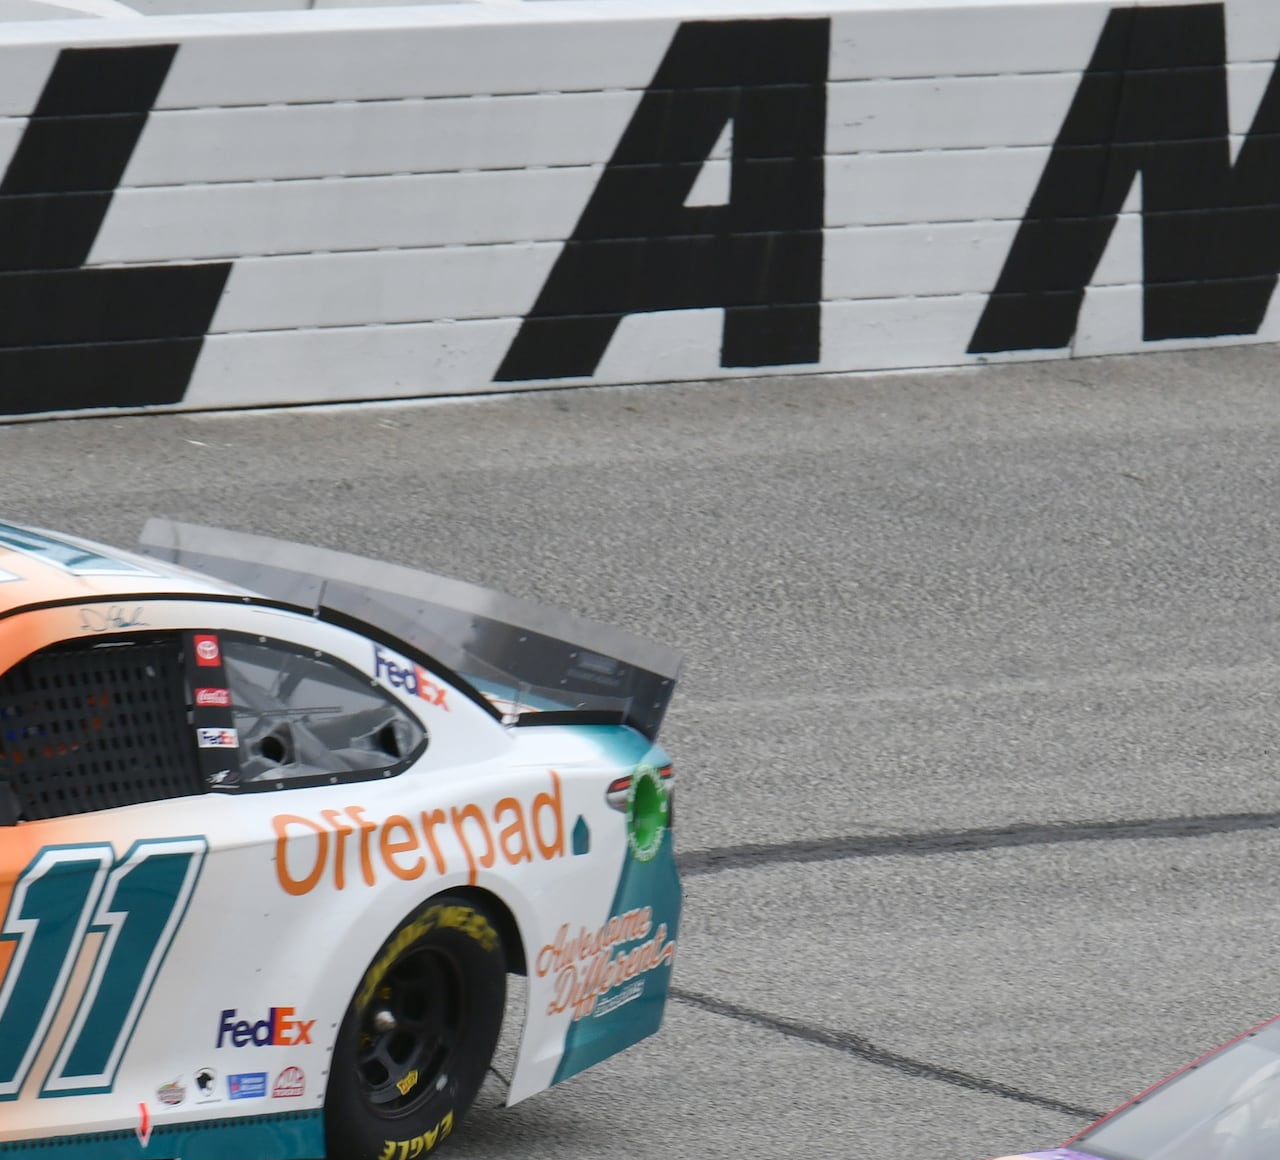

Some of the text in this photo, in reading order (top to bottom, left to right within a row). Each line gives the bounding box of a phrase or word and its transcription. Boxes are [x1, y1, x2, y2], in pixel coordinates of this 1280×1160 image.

[372, 641, 452, 712] FedEx
[272, 770, 565, 897] Offerpad
[215, 1006, 318, 1049] FedEx
